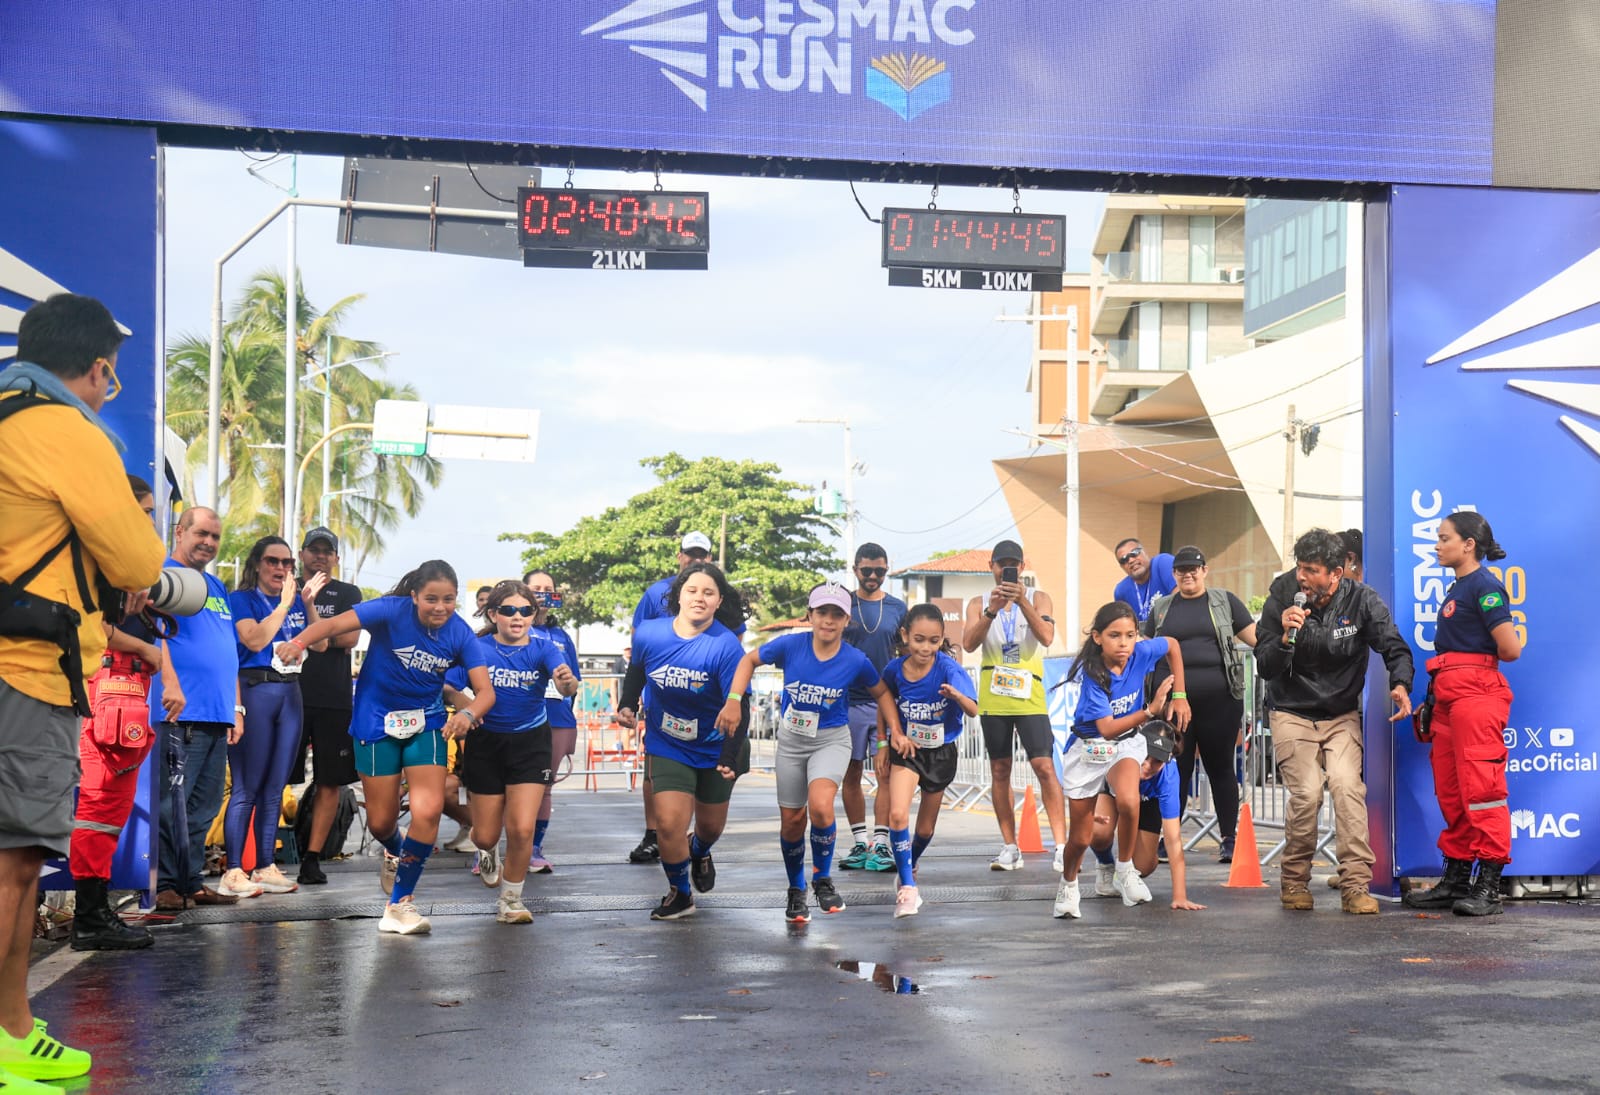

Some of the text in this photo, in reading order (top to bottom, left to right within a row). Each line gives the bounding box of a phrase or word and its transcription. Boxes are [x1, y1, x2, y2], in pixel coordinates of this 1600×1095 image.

[718, 0, 976, 46] CESMAC
[717, 34, 851, 94] RUN
[523, 195, 703, 237] 02:40:42
[889, 214, 1056, 256] 01:44:45
[592, 250, 646, 270] 21KM
[922, 269, 1032, 291] 5KM 10KM
[1411, 489, 1446, 651] CESMAC
[410, 659, 434, 673] RUN
[666, 666, 709, 681] CESMAC
[495, 668, 540, 680] CESMAC
[494, 677, 519, 688] RUN
[665, 676, 688, 689] RUN
[799, 683, 843, 698] CESMAC
[798, 692, 823, 706] RUN
[910, 698, 948, 712] CESMAC
[389, 718, 417, 728] 2390
[666, 720, 692, 734] 2389
[786, 714, 812, 727] 2387
[911, 730, 938, 740] 2385
[1504, 752, 1597, 772] acOficial
[1511, 808, 1581, 838] MAC
